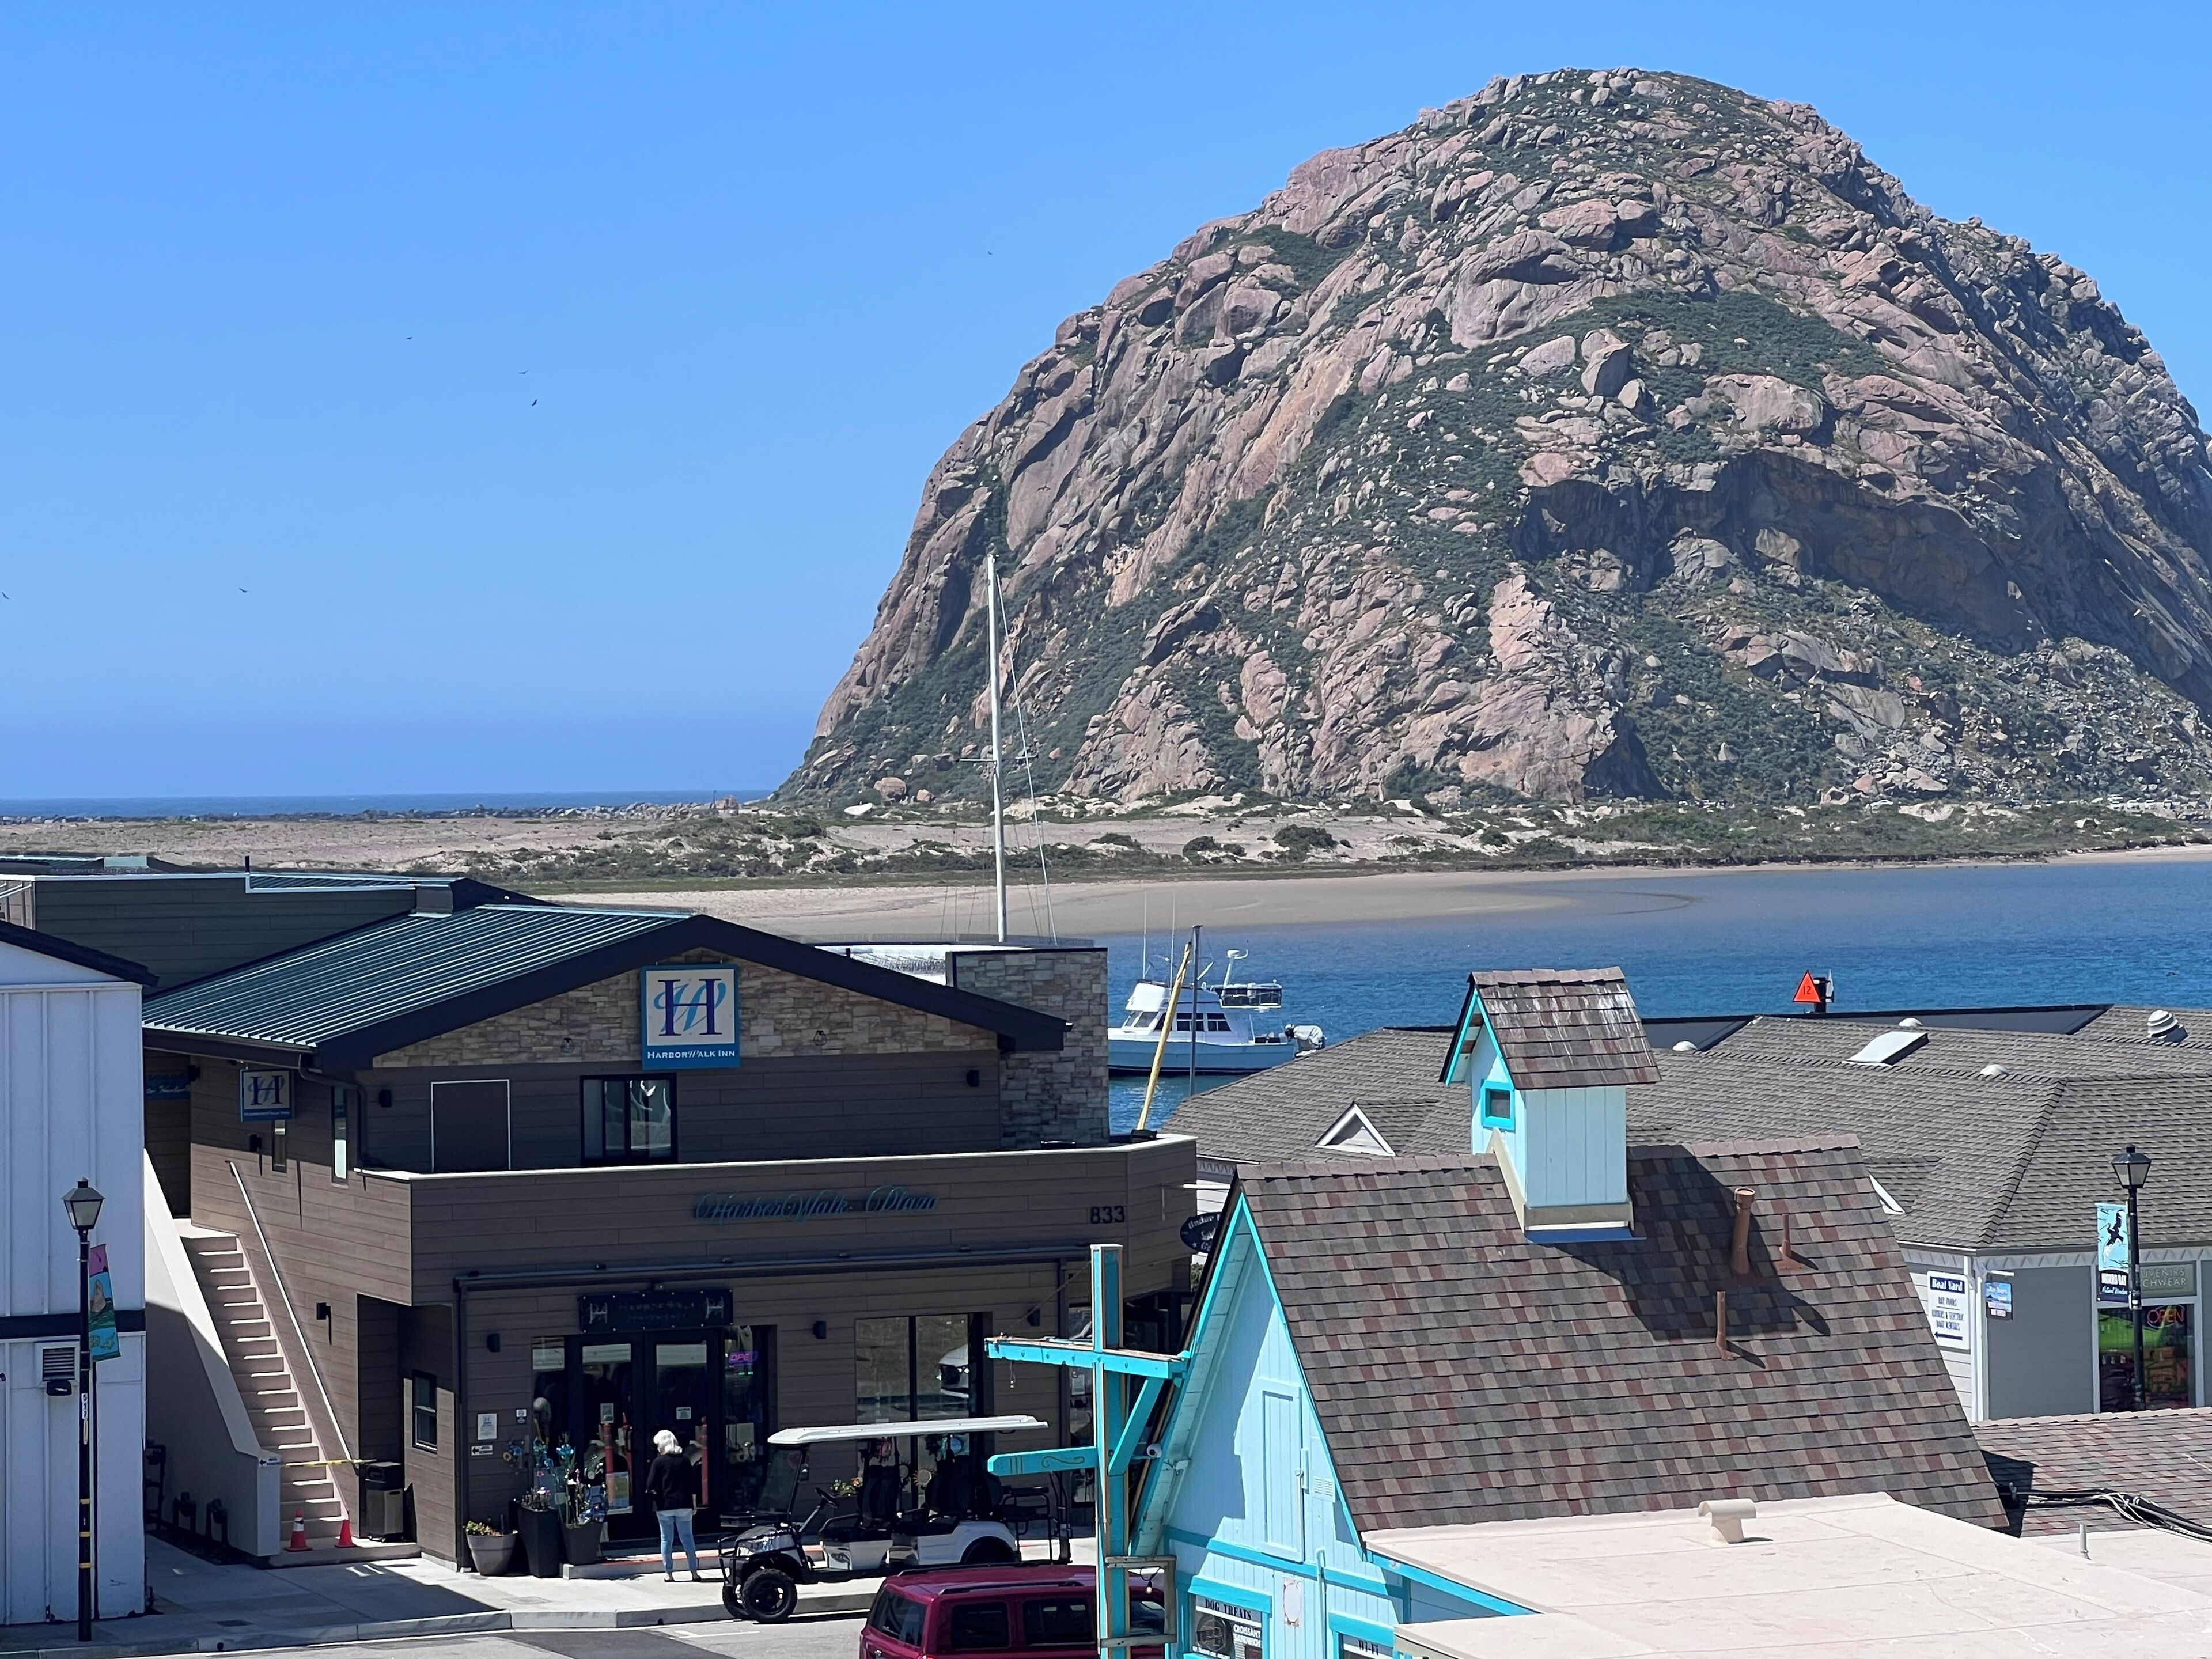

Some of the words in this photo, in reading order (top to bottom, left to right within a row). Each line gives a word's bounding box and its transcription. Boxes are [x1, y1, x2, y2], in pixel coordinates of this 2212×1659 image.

[1803, 986, 1812, 995] 12
[1090, 1205, 1125, 1224] 833
[2141, 1268, 2184, 1278] UVENIRS
[2142, 1278, 2186, 1287] CHWEAR
[2147, 1308, 2184, 1324] OPEN
[1205, 1599, 1219, 1612] DOG
[1223, 1604, 1252, 1620] TREATS
[1233, 1624, 1261, 1639] CROISSANT
[1358, 1638, 1378, 1656] Wi-Fi
